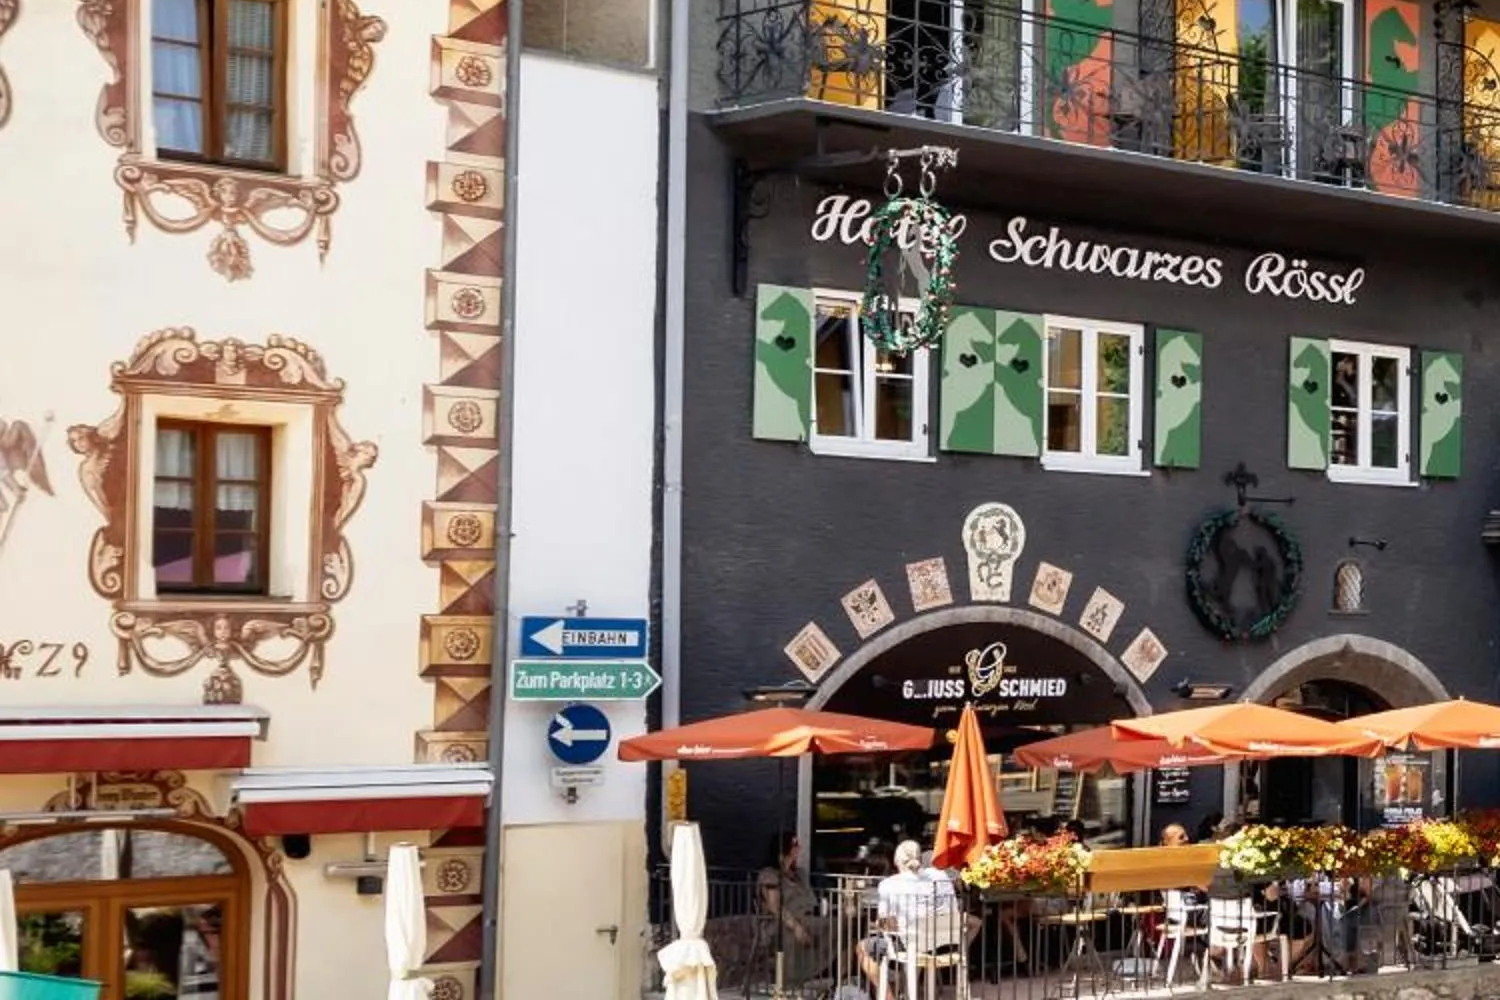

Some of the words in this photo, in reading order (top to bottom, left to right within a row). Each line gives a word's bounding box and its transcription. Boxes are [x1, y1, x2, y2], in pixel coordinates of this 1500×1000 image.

[989, 216, 1223, 289] Schwarzes
[1245, 252, 1366, 305] Rössl
[562, 630, 628, 646] EINBAHN
[515, 670, 548, 690] Zum
[550, 670, 616, 693] Parkplatz
[620, 671, 643, 690] 1-3
[999, 678, 1067, 697] SCHMIED
